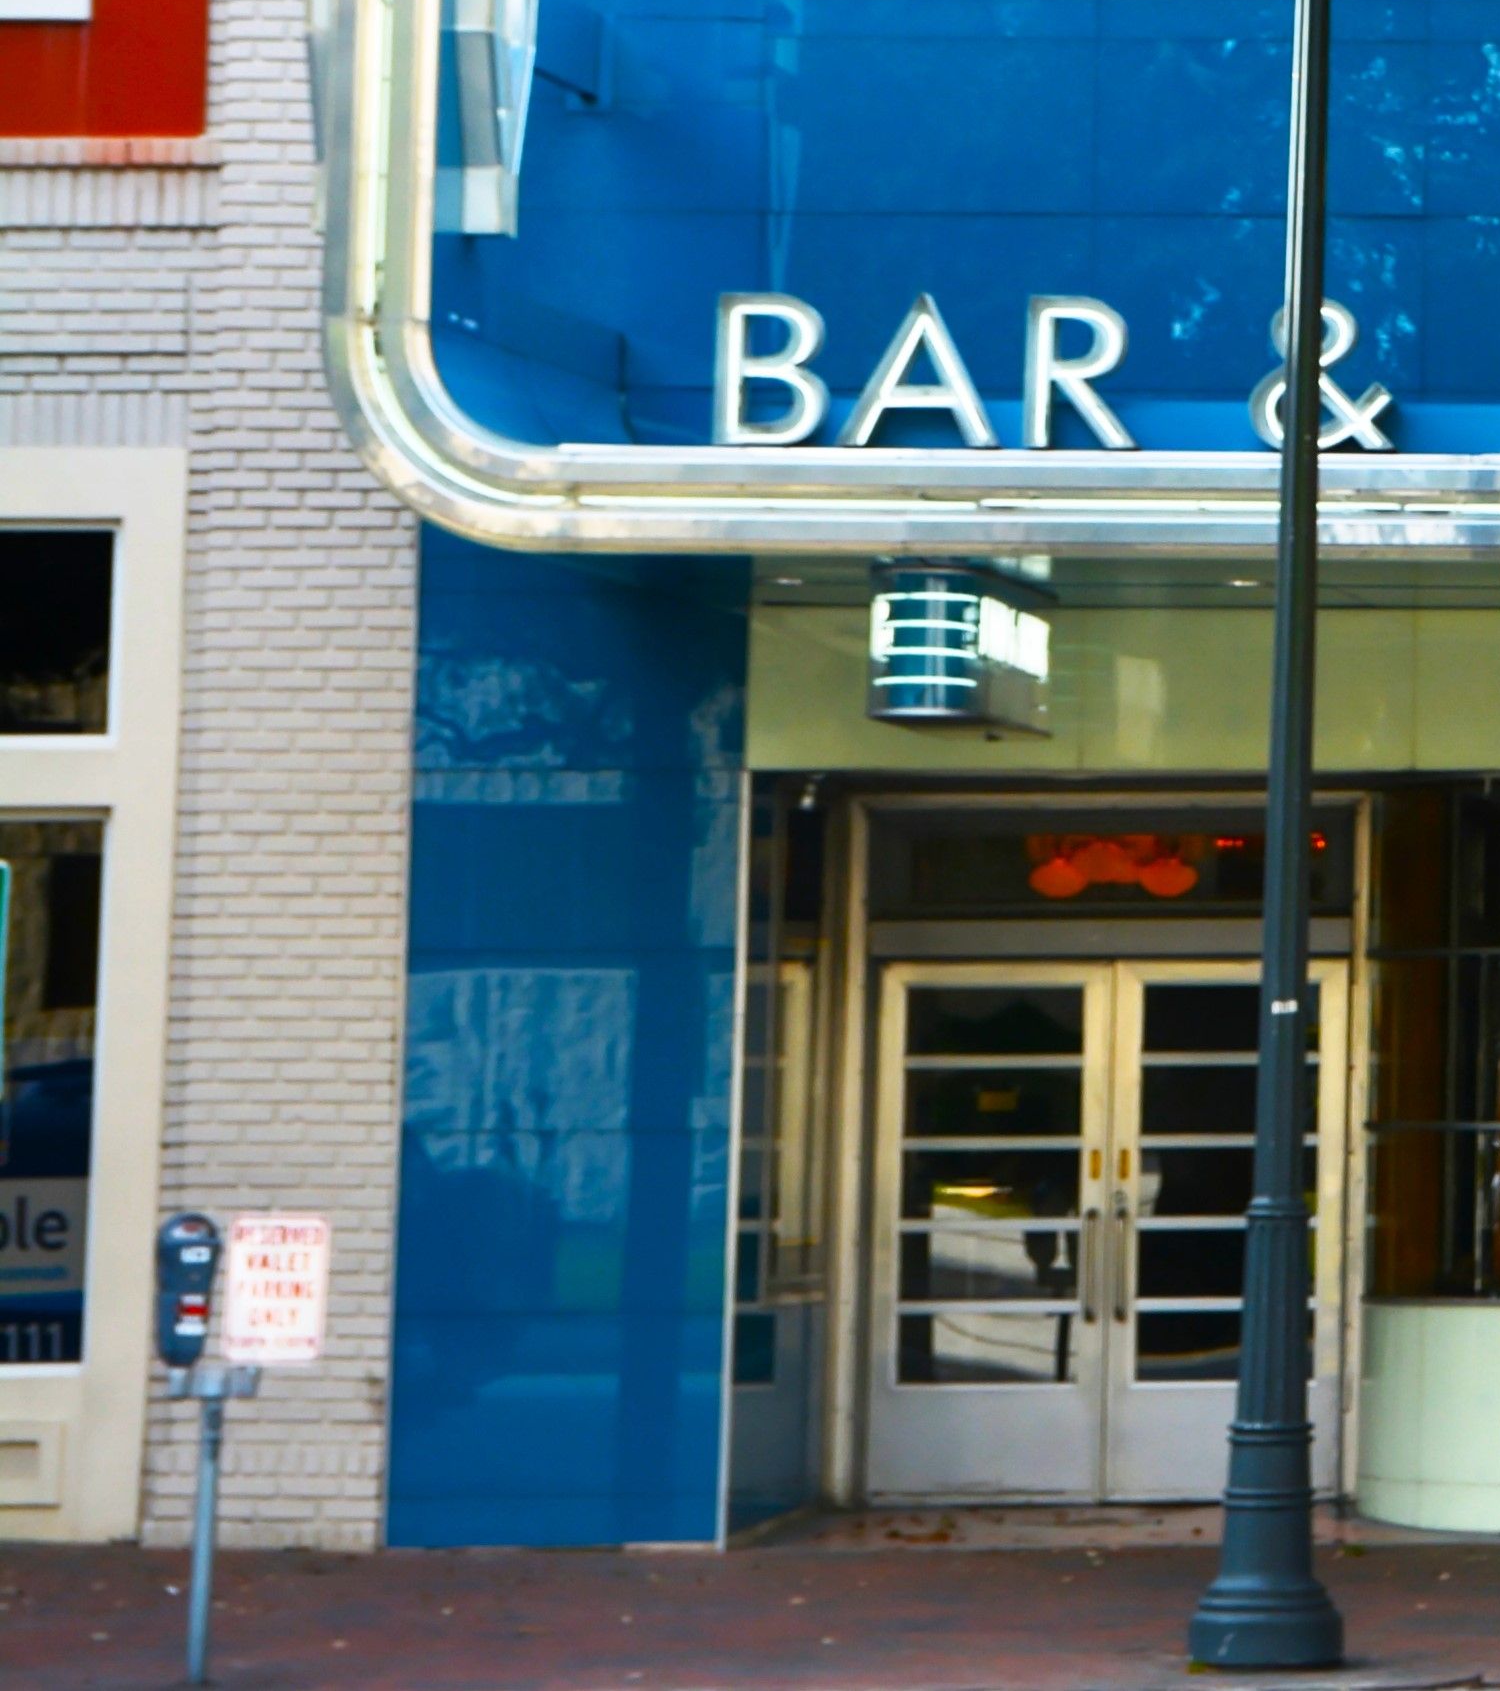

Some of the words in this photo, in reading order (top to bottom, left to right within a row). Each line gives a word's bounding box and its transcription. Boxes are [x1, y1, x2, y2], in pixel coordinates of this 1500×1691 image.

[713, 292, 1140, 450] BAR
[1248, 298, 1396, 450] &
[246, 1252, 311, 1272] VALET
